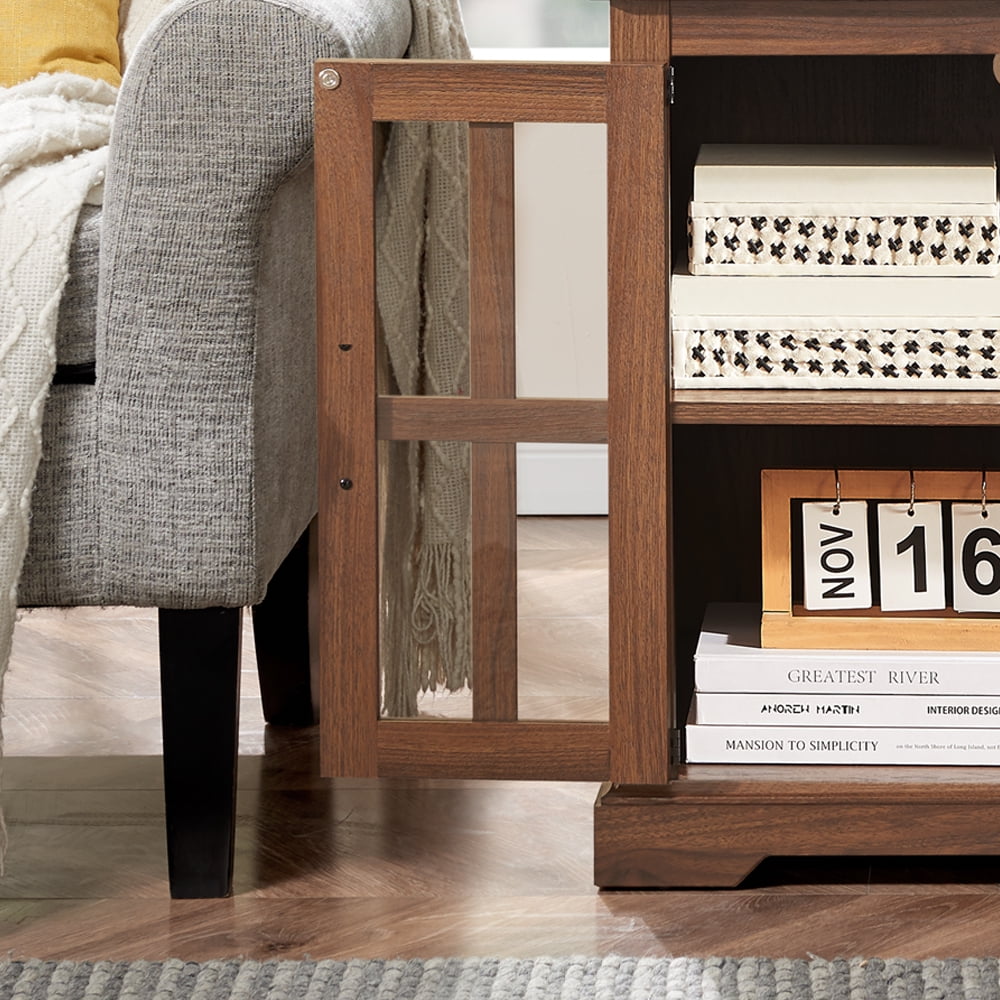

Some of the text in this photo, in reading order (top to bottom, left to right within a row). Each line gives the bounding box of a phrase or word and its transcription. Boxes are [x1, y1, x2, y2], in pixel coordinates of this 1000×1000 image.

[819, 523, 855, 599] NOV
[787, 669, 940, 685] GREATEST RIVER
[816, 705, 860, 715] MARTIN
[927, 705, 969, 715] INTERIOR
[725, 740, 879, 752] MANSION TO SIMPLICITY
